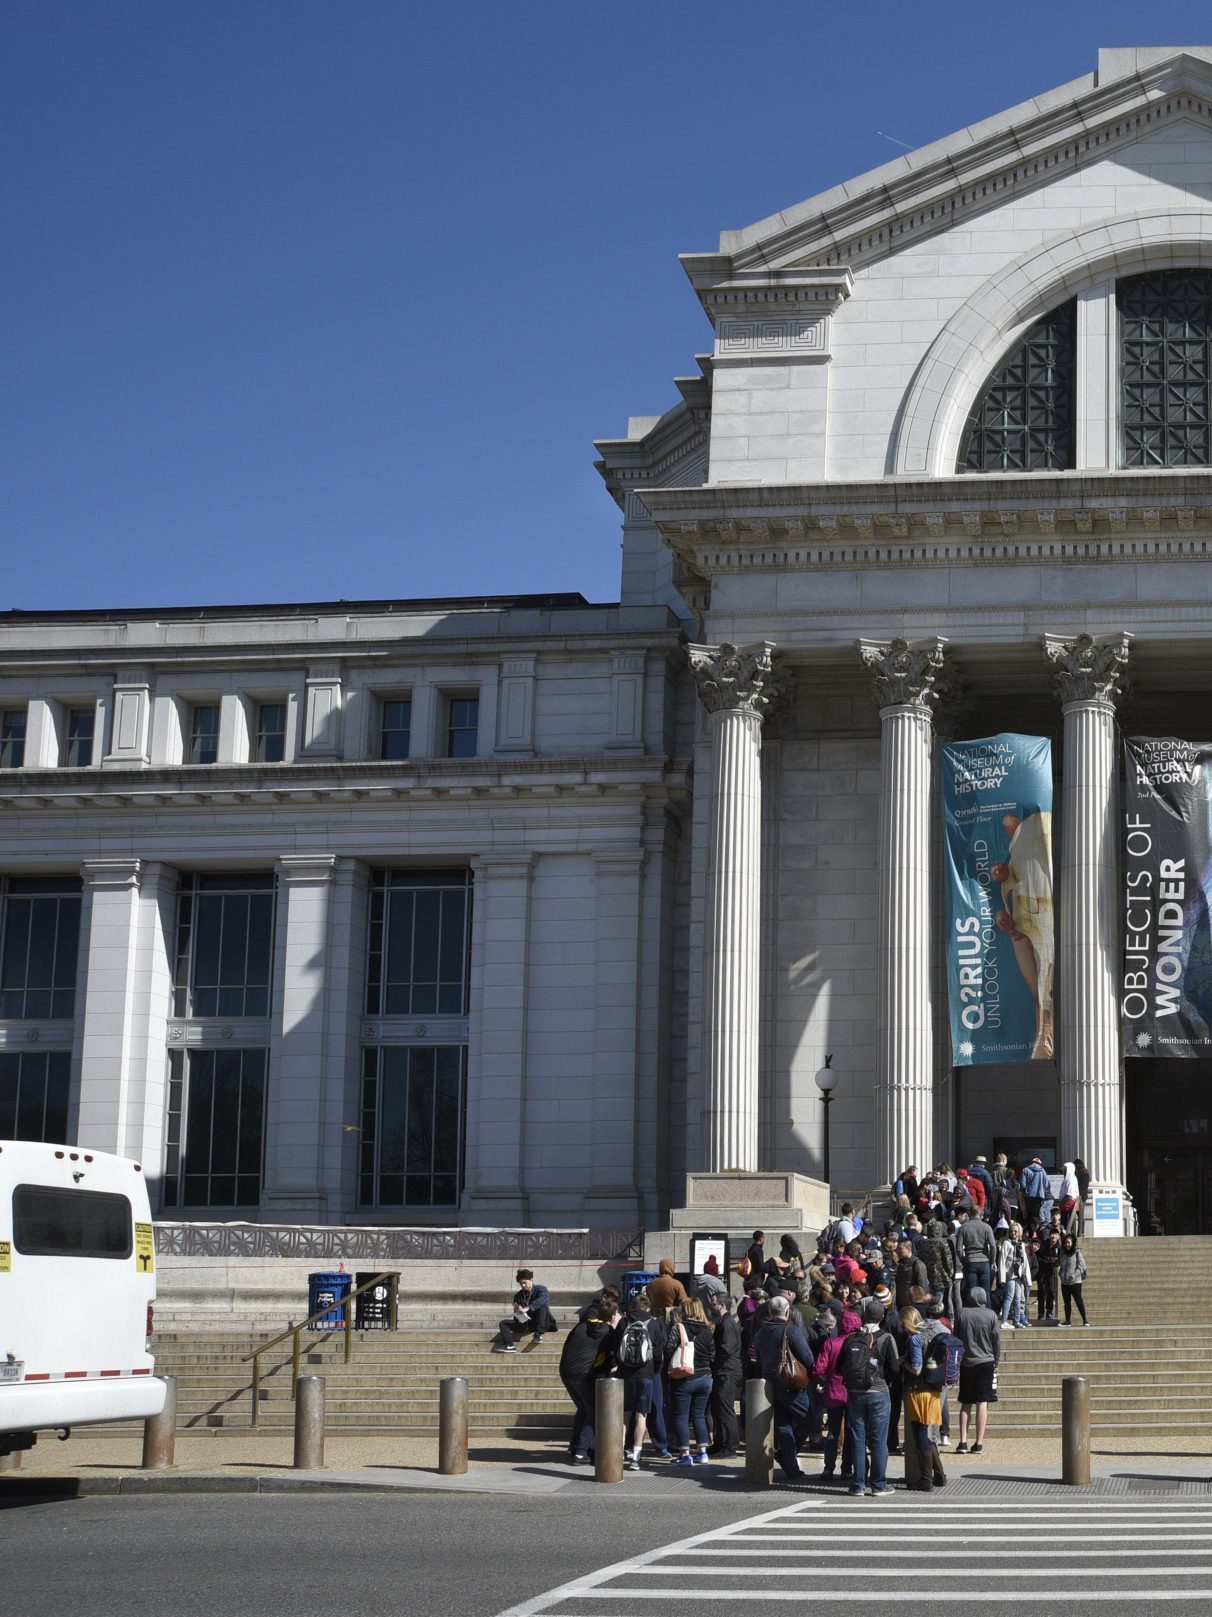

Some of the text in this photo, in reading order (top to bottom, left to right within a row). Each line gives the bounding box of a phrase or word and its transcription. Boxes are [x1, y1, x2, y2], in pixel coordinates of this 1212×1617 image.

[953, 743, 1013, 759] NATIONAL
[1133, 740, 1198, 754] NATIONAL
[953, 753, 1017, 771] MUSEUM of
[1136, 750, 1200, 765] MUSEUM of
[954, 765, 1009, 783] NATURAL
[1136, 761, 1193, 775] NATURAL
[954, 777, 1003, 795] HISTORY
[1136, 772, 1188, 785] HISTORY
[1136, 791, 1149, 799] 2nd
[1123, 813, 1152, 1019] OBJECTS OF
[974, 839, 1002, 1029] UNLOCK YOUR WORLD
[1155, 858, 1186, 1018] WONDER
[955, 916, 985, 1030] Q?RIUS
[981, 1042, 1028, 1052] Smithsonian
[1157, 1036, 1203, 1045] Smithsonian
